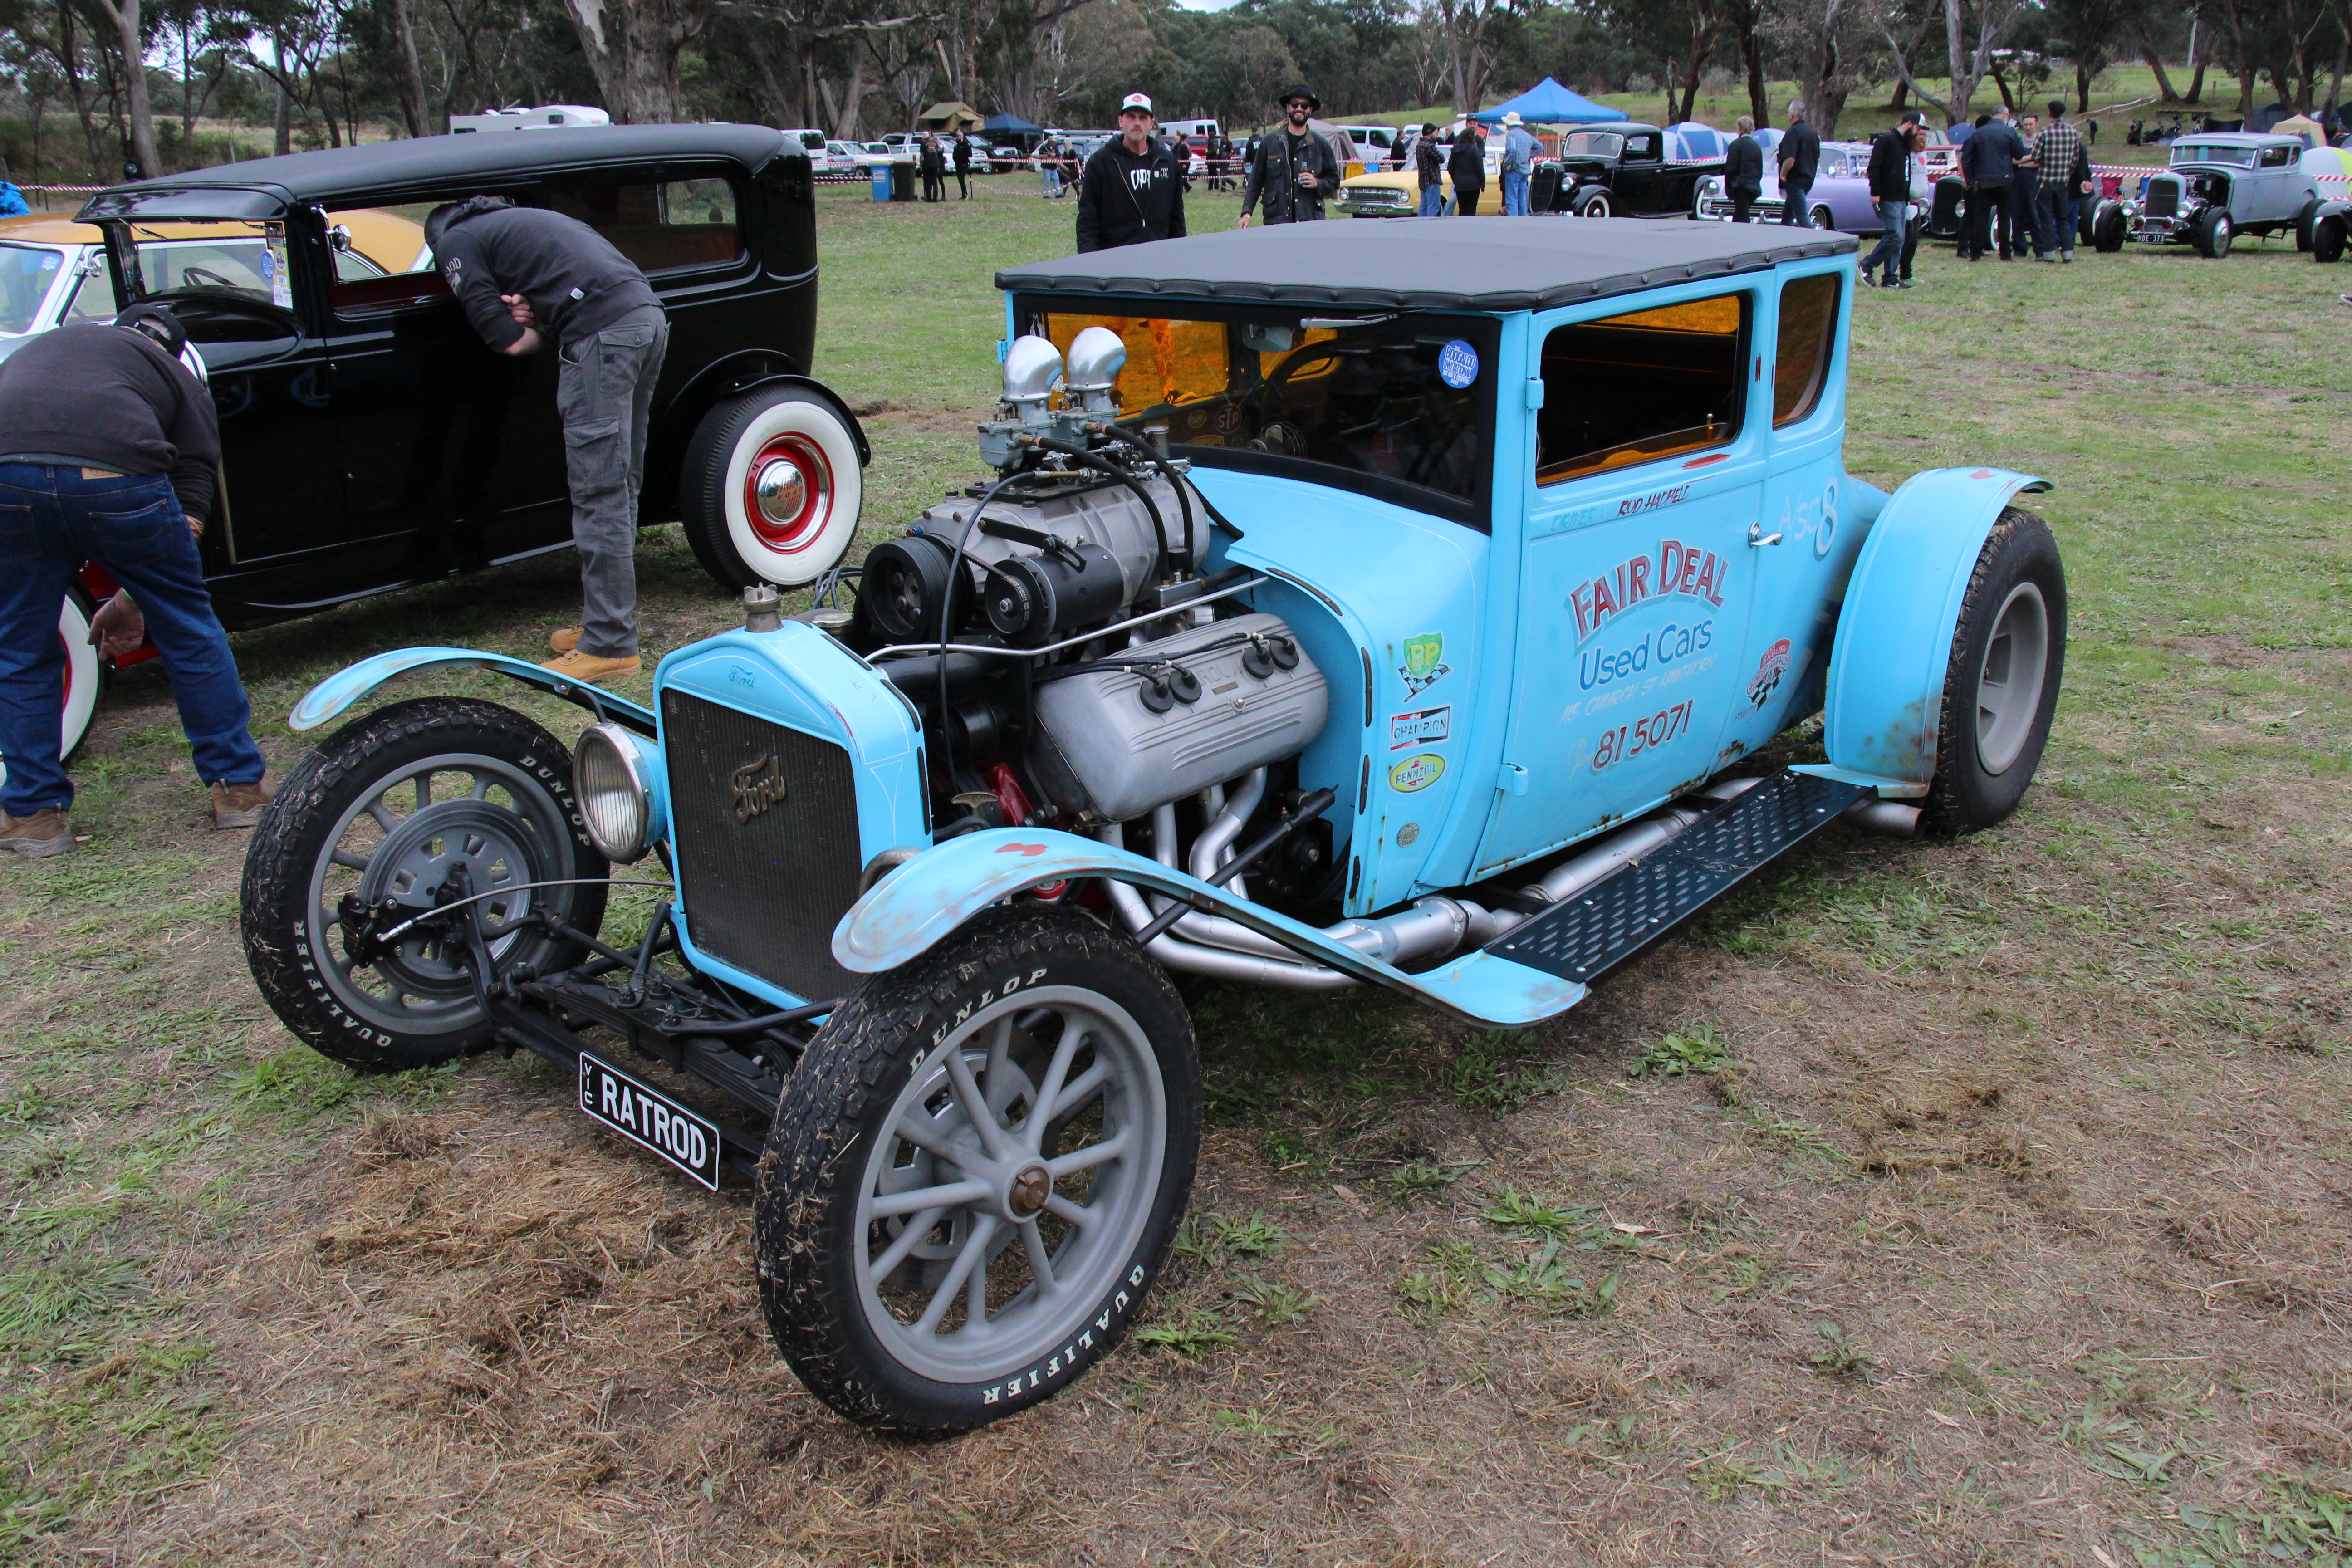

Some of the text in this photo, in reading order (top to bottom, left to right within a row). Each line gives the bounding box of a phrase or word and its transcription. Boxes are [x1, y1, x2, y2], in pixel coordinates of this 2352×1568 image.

[1445, 345, 1476, 368] BOOGALOO
[1218, 409, 1238, 429] STP
[777, 486, 803, 500] FORD
[1617, 498, 1643, 518] ROD
[1813, 477, 1838, 562] 8
[1569, 540, 1730, 644] FAIR DEAL
[728, 665, 755, 687] Ford
[1410, 642, 1439, 668] BP
[1580, 619, 1714, 691] Used Cars
[1641, 676, 1660, 696] ST
[1394, 719, 1446, 739] CHAMPION
[1593, 726, 1627, 769] 81
[1629, 699, 1694, 756] 5071
[520, 755, 590, 847] DUNLOP
[730, 753, 785, 823] Ford
[1395, 763, 1436, 785] PENNZOIL
[293, 921, 392, 1047] QUALIFIER
[909, 968, 1047, 1073] DUNLOP
[584, 1062, 593, 1104] VIC
[602, 1073, 706, 1169] RATROD
[983, 1264, 1144, 1405] QUALIFIER
